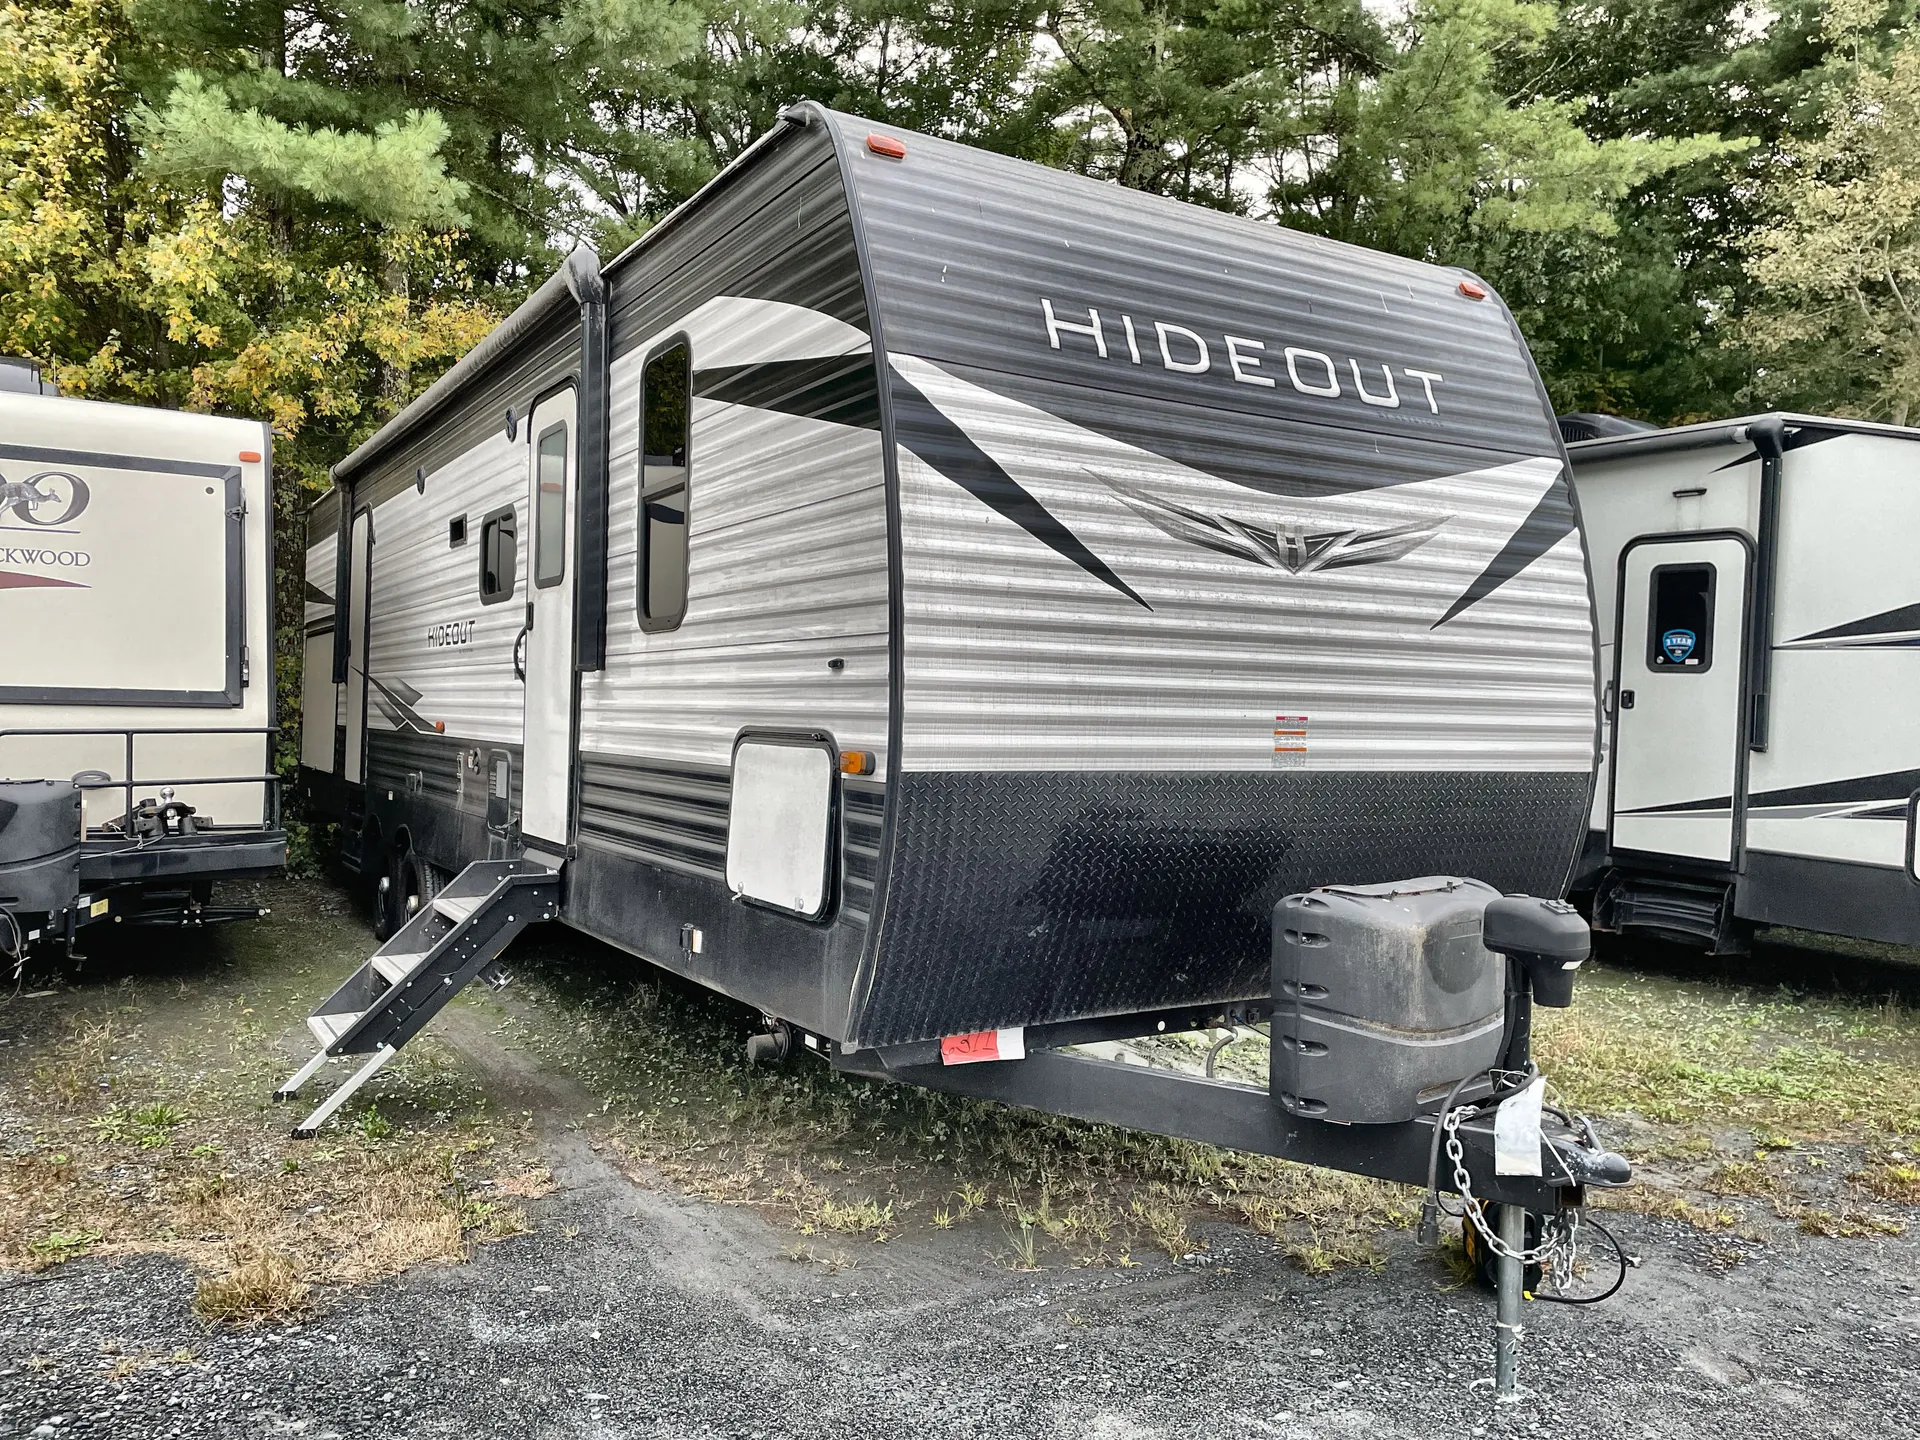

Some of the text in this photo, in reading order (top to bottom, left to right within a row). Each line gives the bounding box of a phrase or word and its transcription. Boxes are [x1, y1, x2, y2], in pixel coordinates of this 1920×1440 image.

[1040, 297, 1445, 416] HIDEOUT
[0, 471, 90, 526] O
[428, 620, 476, 648] HIDEOUT
[1672, 637, 1692, 646] YEAR
